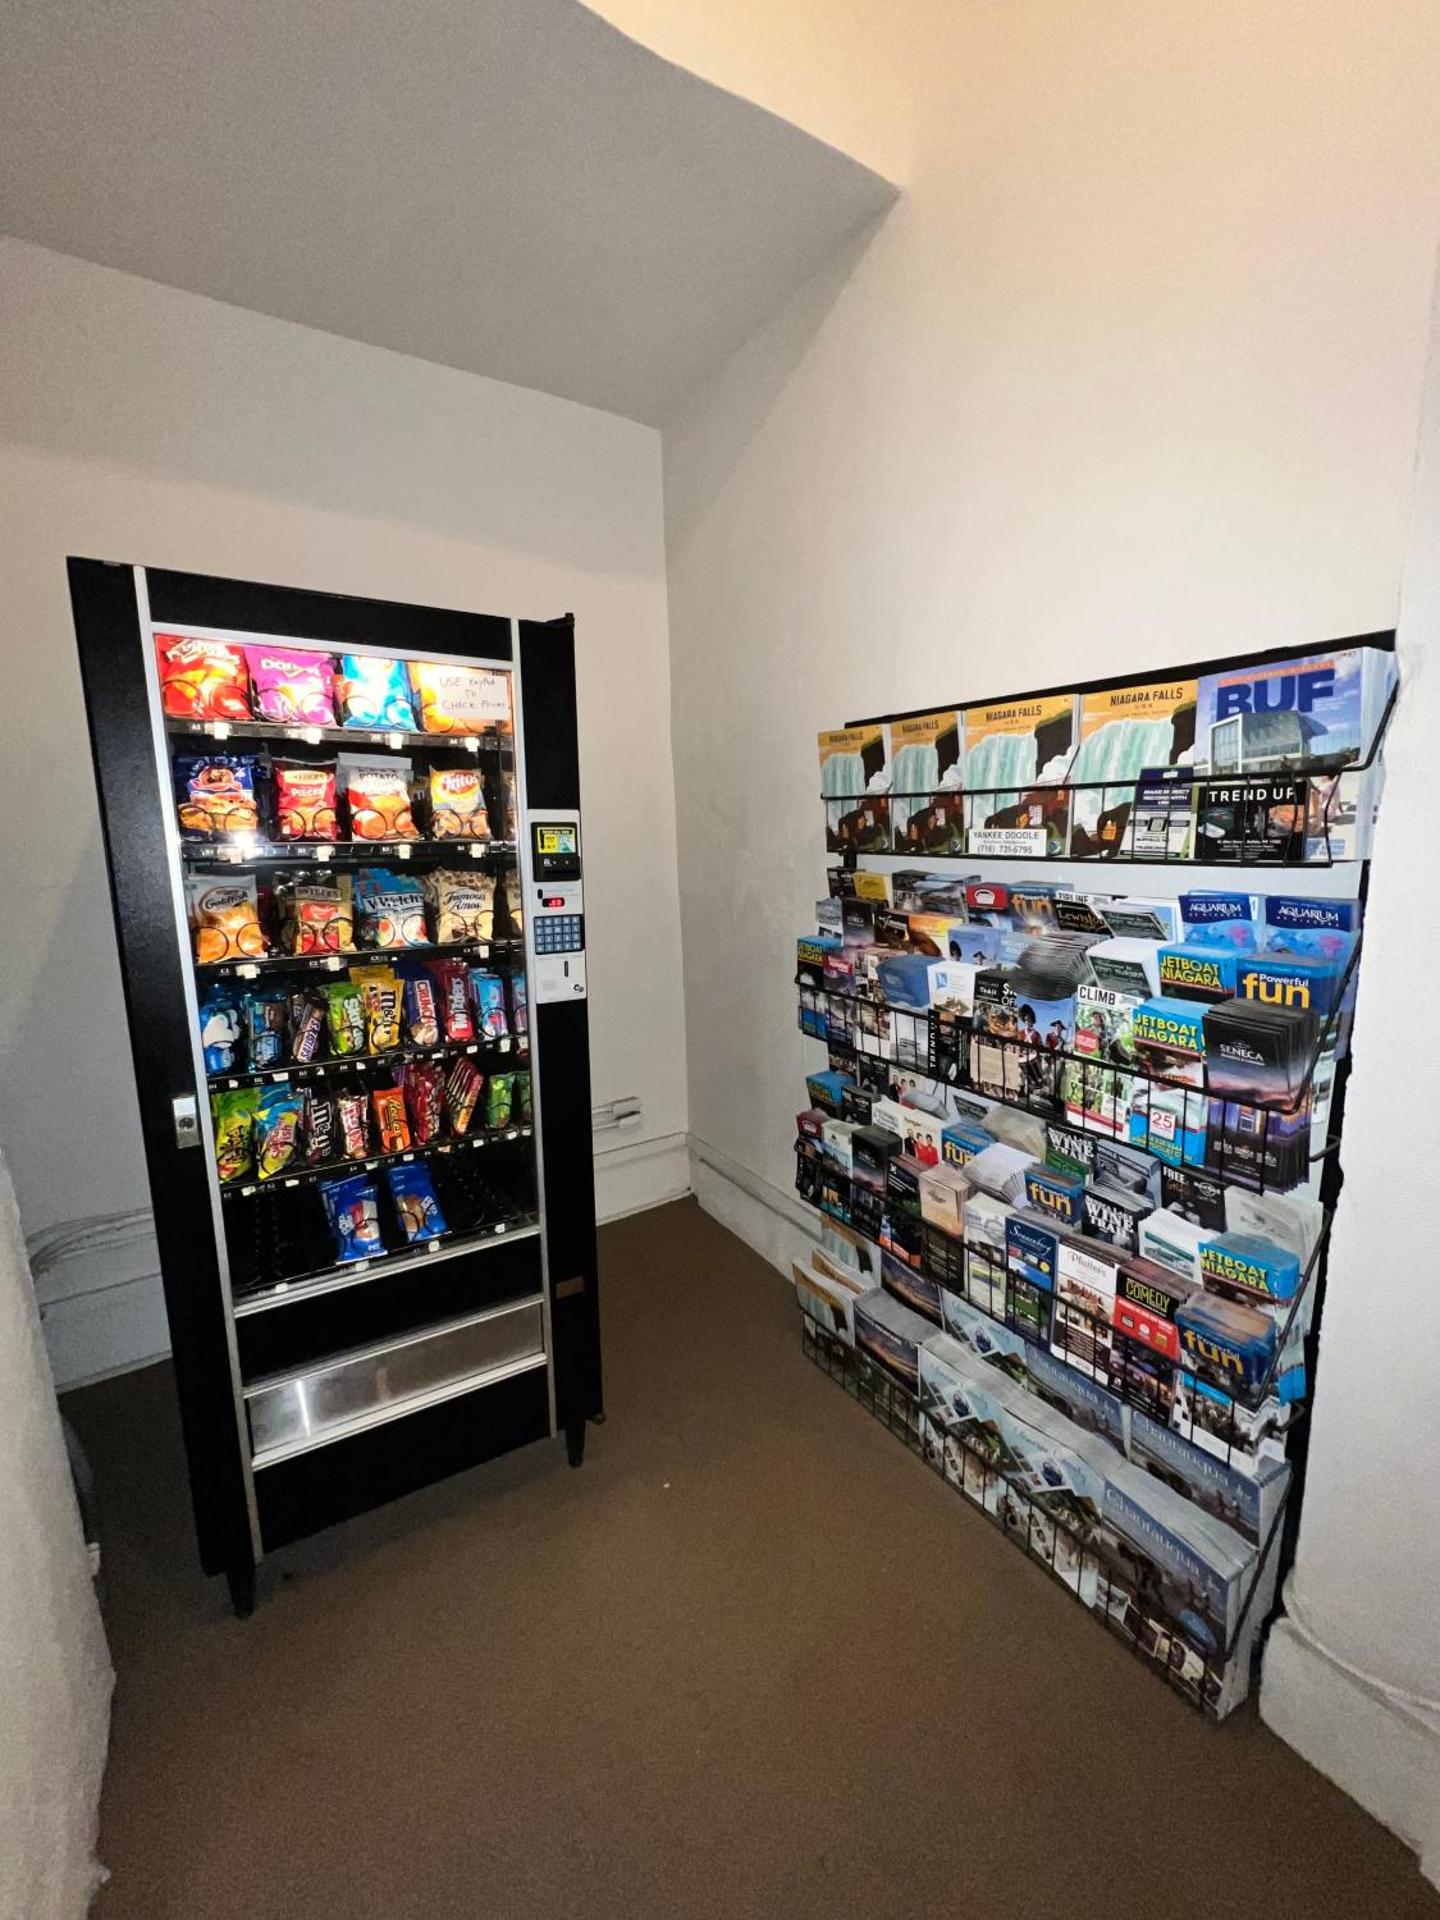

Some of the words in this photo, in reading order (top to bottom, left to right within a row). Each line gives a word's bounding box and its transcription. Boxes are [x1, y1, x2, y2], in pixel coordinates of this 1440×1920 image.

[439, 677, 461, 689] USE
[1110, 692, 1150, 707] NIAGARA
[1153, 687, 1184, 701] FALLS
[1217, 669, 1335, 721] BUF
[985, 709, 1017, 722] NIAGARA
[1018, 705, 1042, 717] FALLS
[1210, 787, 1267, 803] TREND
[973, 831, 1003, 840] YANKEE
[1005, 831, 1041, 841] DOODLE
[448, 890, 486, 904] Famous
[1189, 902, 1242, 913] AQUARIUM
[1277, 905, 1340, 922] AQUARIUM
[1160, 956, 1219, 973] JETBOAT
[1160, 966, 1222, 988] NIAGARA
[1258, 973, 1309, 987] Powerful
[1079, 986, 1116, 1006] CLIMB
[1242, 974, 1311, 1009] fun
[1135, 1013, 1198, 1037] JETBOAT
[1134, 1024, 1198, 1050] NIAGARA
[1219, 1044, 1265, 1062] SENECA
[1152, 1111, 1173, 1129] 25
[1162, 1165, 1185, 1185] FREE
[1085, 1194, 1134, 1234] WINE
[1200, 1247, 1267, 1279] JETBOAT
[1200, 1258, 1270, 1293] NIAGARA
[1125, 1278, 1171, 1313] COMEDY
[1183, 1328, 1245, 1375] fun
